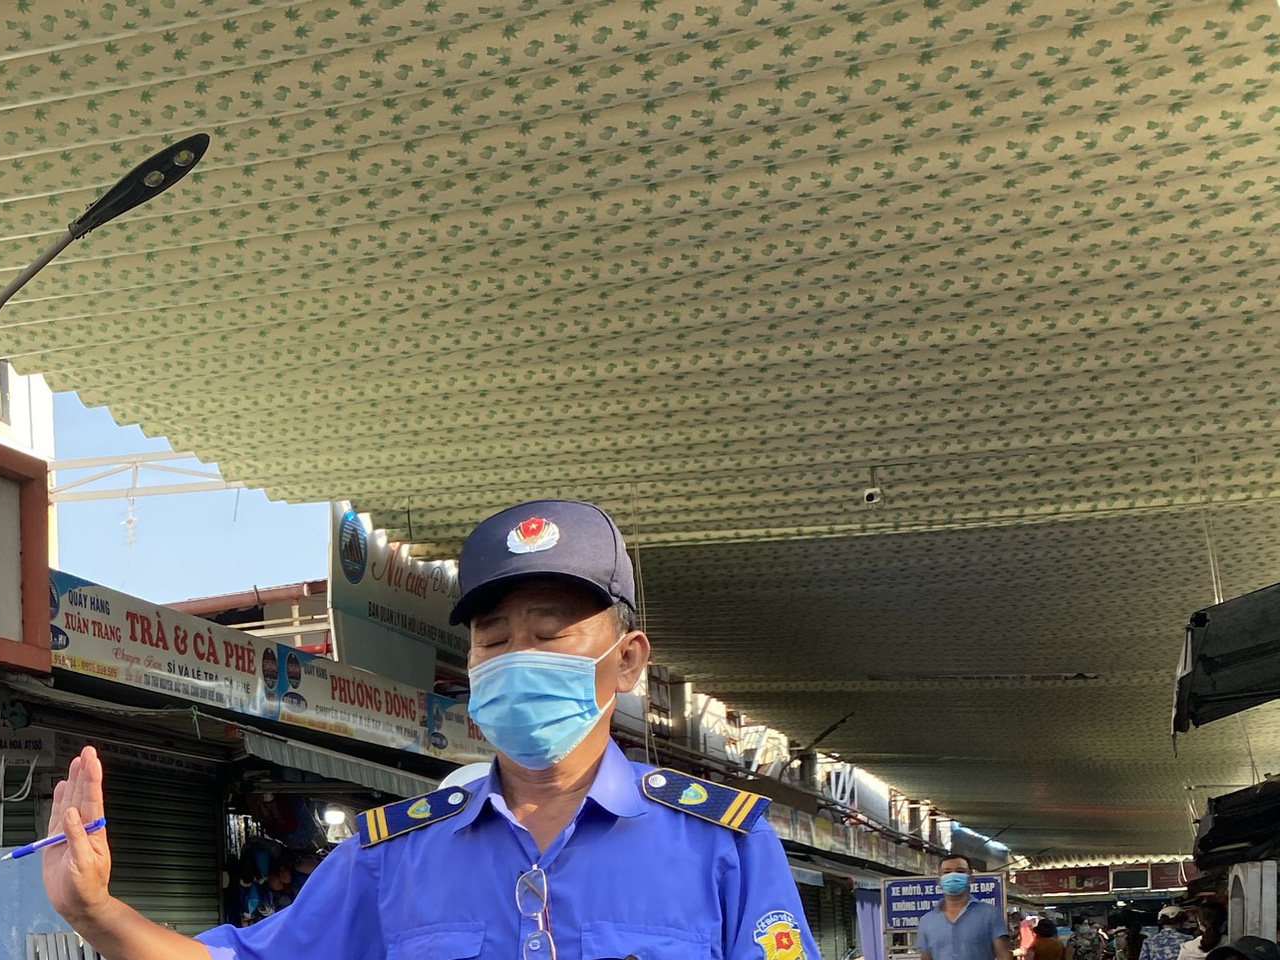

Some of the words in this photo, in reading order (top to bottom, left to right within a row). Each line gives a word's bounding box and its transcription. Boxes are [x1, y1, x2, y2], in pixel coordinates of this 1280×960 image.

[91, 620, 122, 644] TRANG
[126, 611, 169, 651] TRÀ
[174, 625, 188, 655] &
[193, 627, 219, 665] CÀ
[223, 641, 256, 676] PHÊ
[178, 663, 190, 678] VÀ
[330, 675, 382, 713] PHƯƠNG
[384, 686, 416, 722] ĐÔNG
